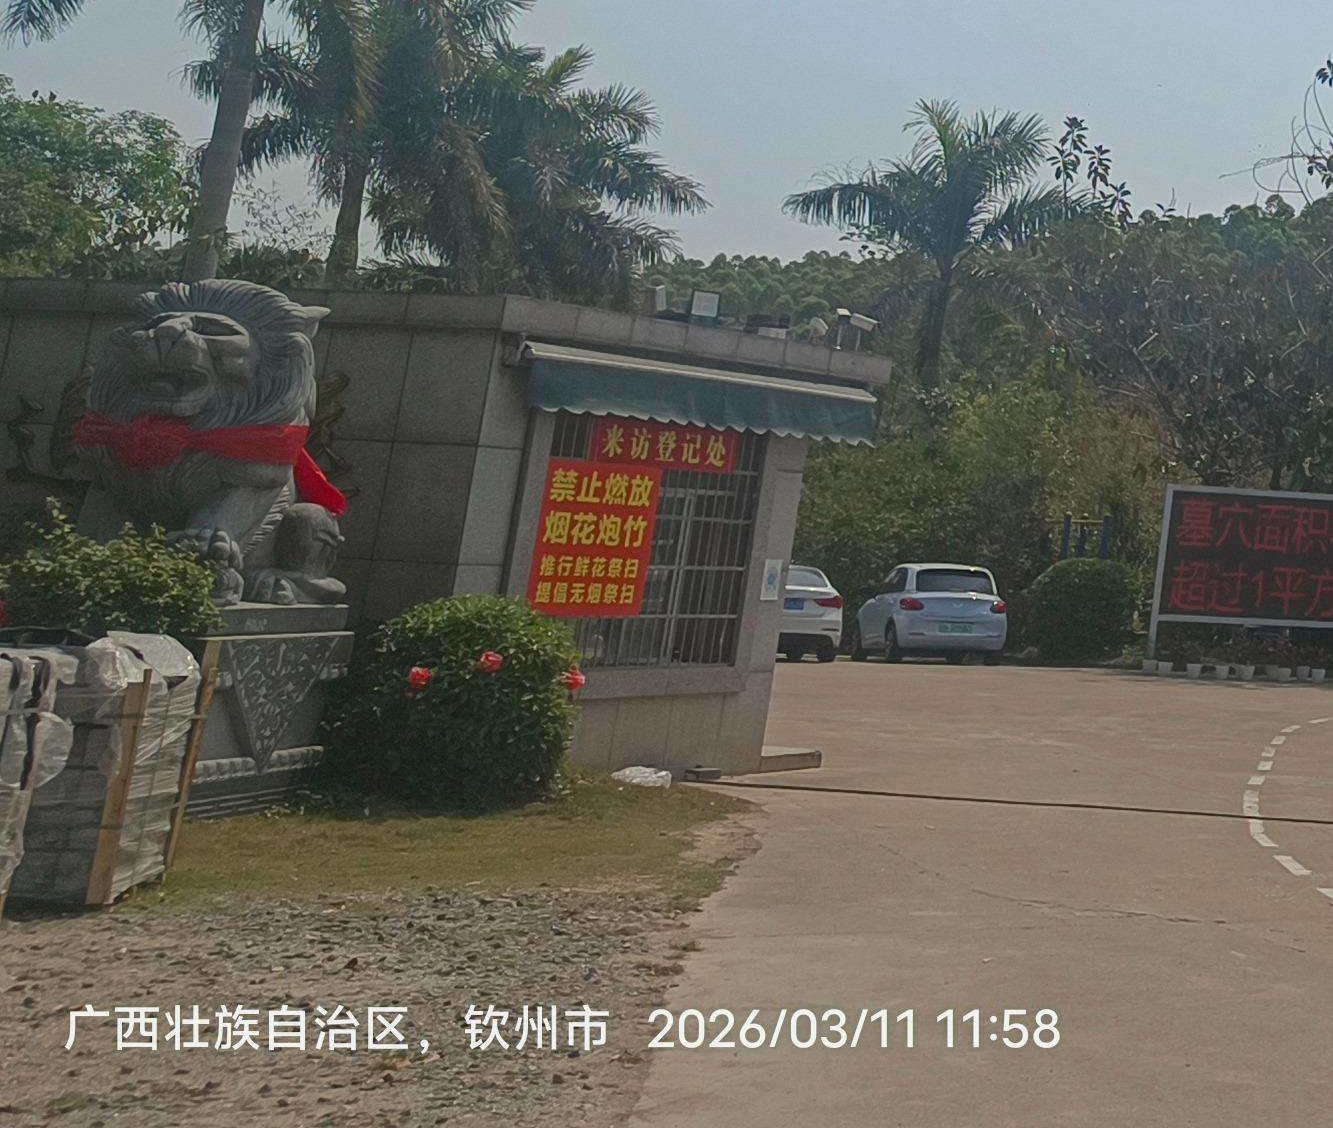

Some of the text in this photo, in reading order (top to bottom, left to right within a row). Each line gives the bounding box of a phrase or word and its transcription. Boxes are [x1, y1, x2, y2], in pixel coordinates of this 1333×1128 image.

[602, 424, 727, 467] 来访登记处
[550, 468, 654, 507] 禁止燃放
[542, 510, 648, 548] 烟花炮竹
[539, 554, 639, 579] 推行鲜花祭扫
[534, 581, 636, 605] 提倡无烟祭扫
